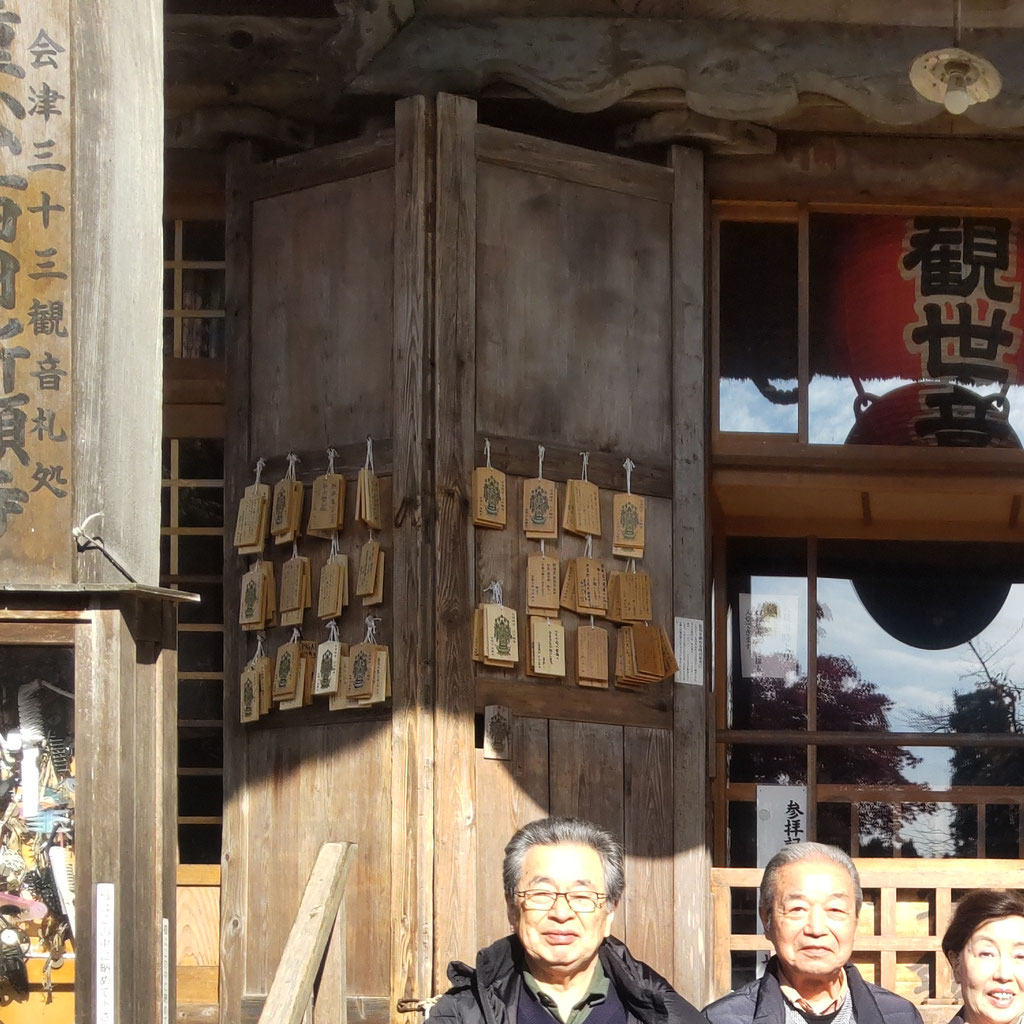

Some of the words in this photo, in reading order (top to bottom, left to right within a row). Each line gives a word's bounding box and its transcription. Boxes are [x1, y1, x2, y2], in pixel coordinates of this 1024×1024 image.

[26, 28, 69, 498] 会津三十三観音札処
[902, 216, 1015, 447] 観世音
